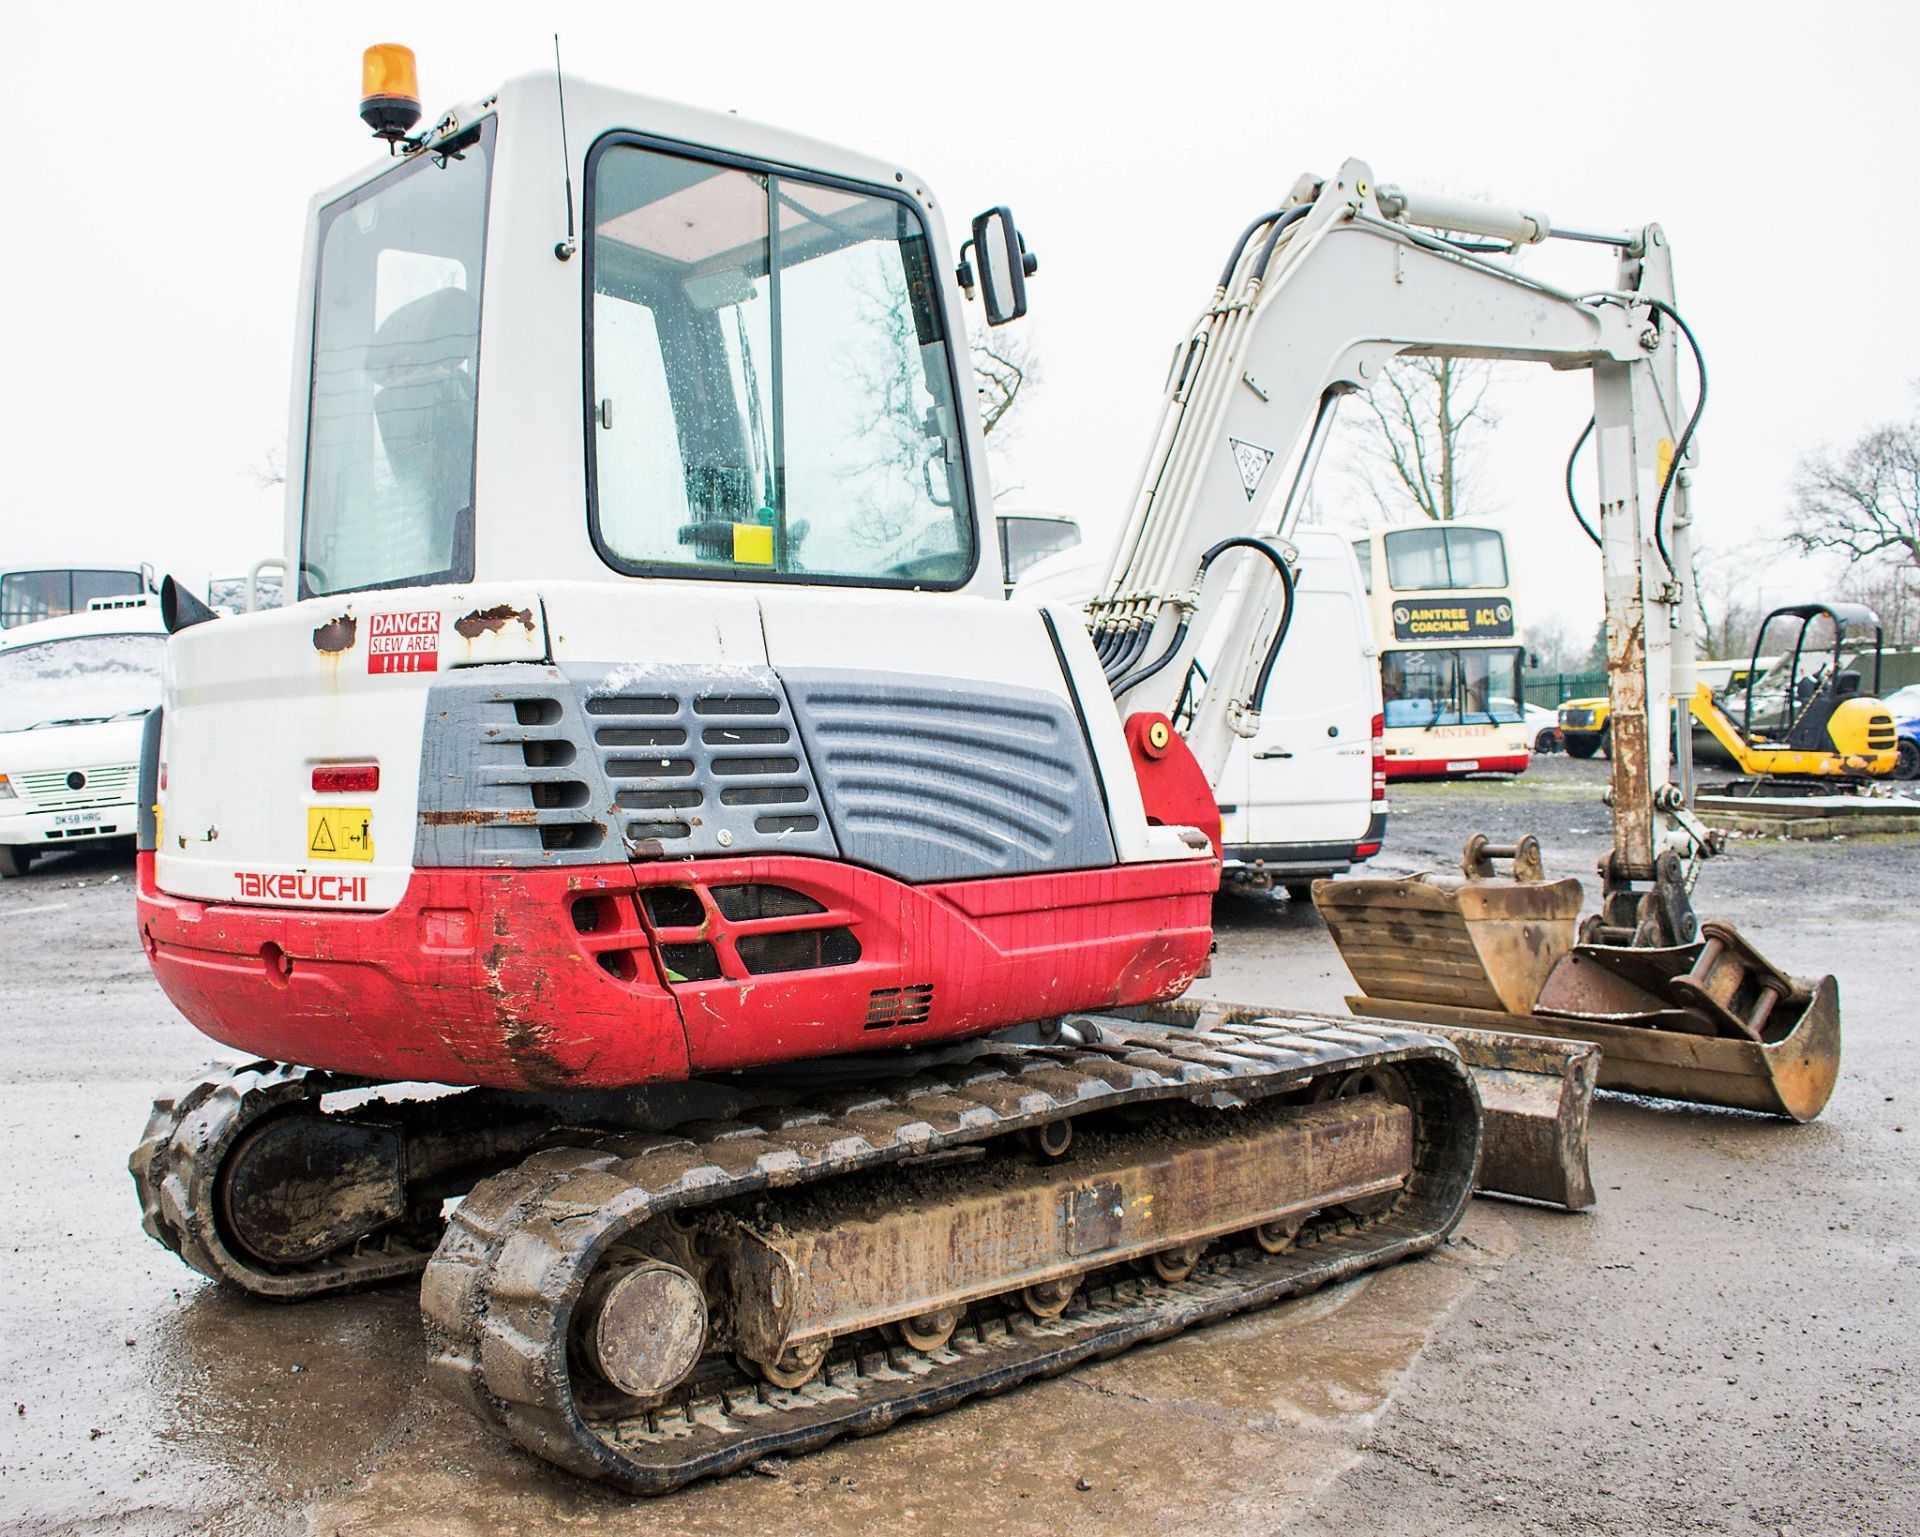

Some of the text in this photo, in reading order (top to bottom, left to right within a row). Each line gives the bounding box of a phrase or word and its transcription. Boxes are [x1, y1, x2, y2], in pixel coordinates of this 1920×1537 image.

[372, 612, 439, 635] DANGER
[1411, 608, 1498, 626] AINTREE ACL
[1410, 621, 1470, 633] COACHLINE
[372, 636, 436, 653] SLEW AREA
